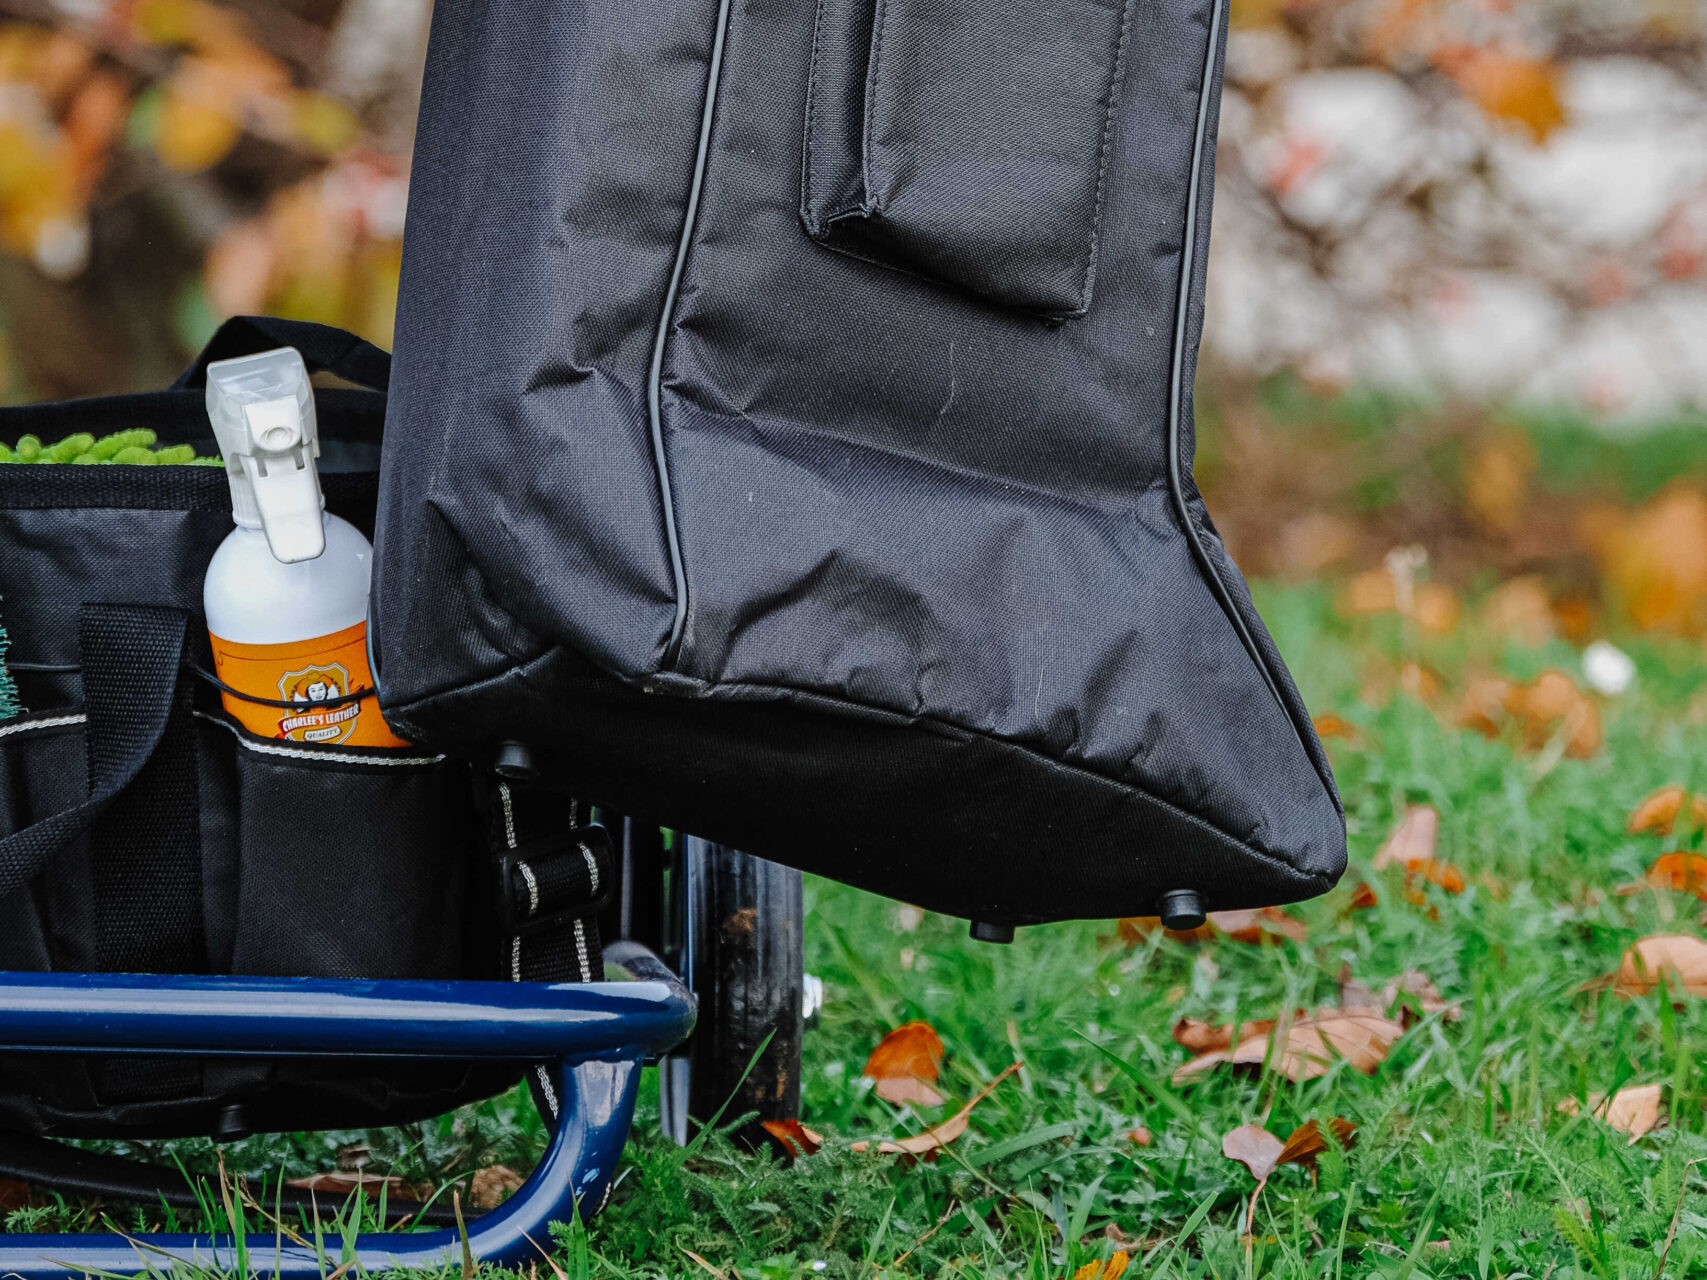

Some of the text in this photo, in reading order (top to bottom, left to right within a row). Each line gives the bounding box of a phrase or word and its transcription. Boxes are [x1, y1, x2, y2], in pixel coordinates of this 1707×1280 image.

[282, 703, 359, 732] CHARLEE'S LEATHER
[307, 728, 338, 739] QUALITY
